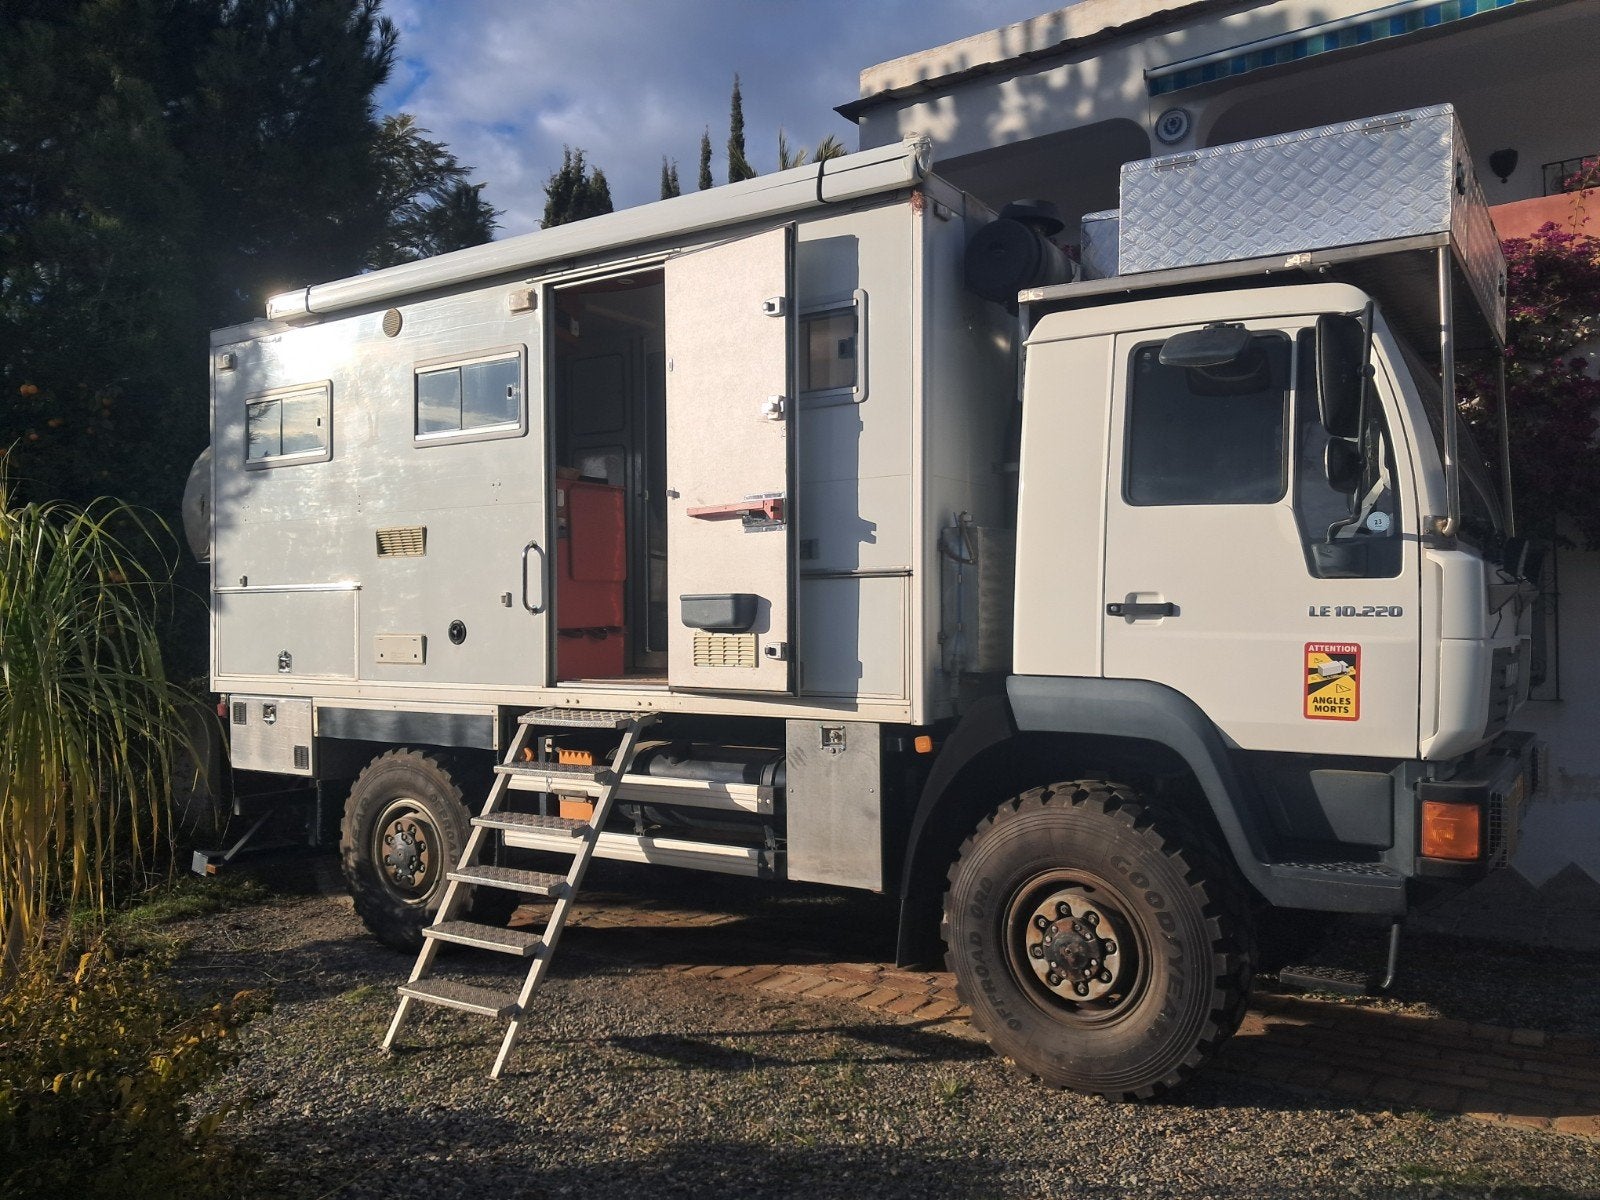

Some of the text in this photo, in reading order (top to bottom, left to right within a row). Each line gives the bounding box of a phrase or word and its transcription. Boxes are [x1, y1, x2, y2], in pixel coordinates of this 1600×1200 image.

[1309, 606, 1403, 617] LE 10.220
[1308, 645, 1357, 653] ATTENTION
[1312, 696, 1351, 705] ANGLES
[1314, 705, 1349, 713] MORTS
